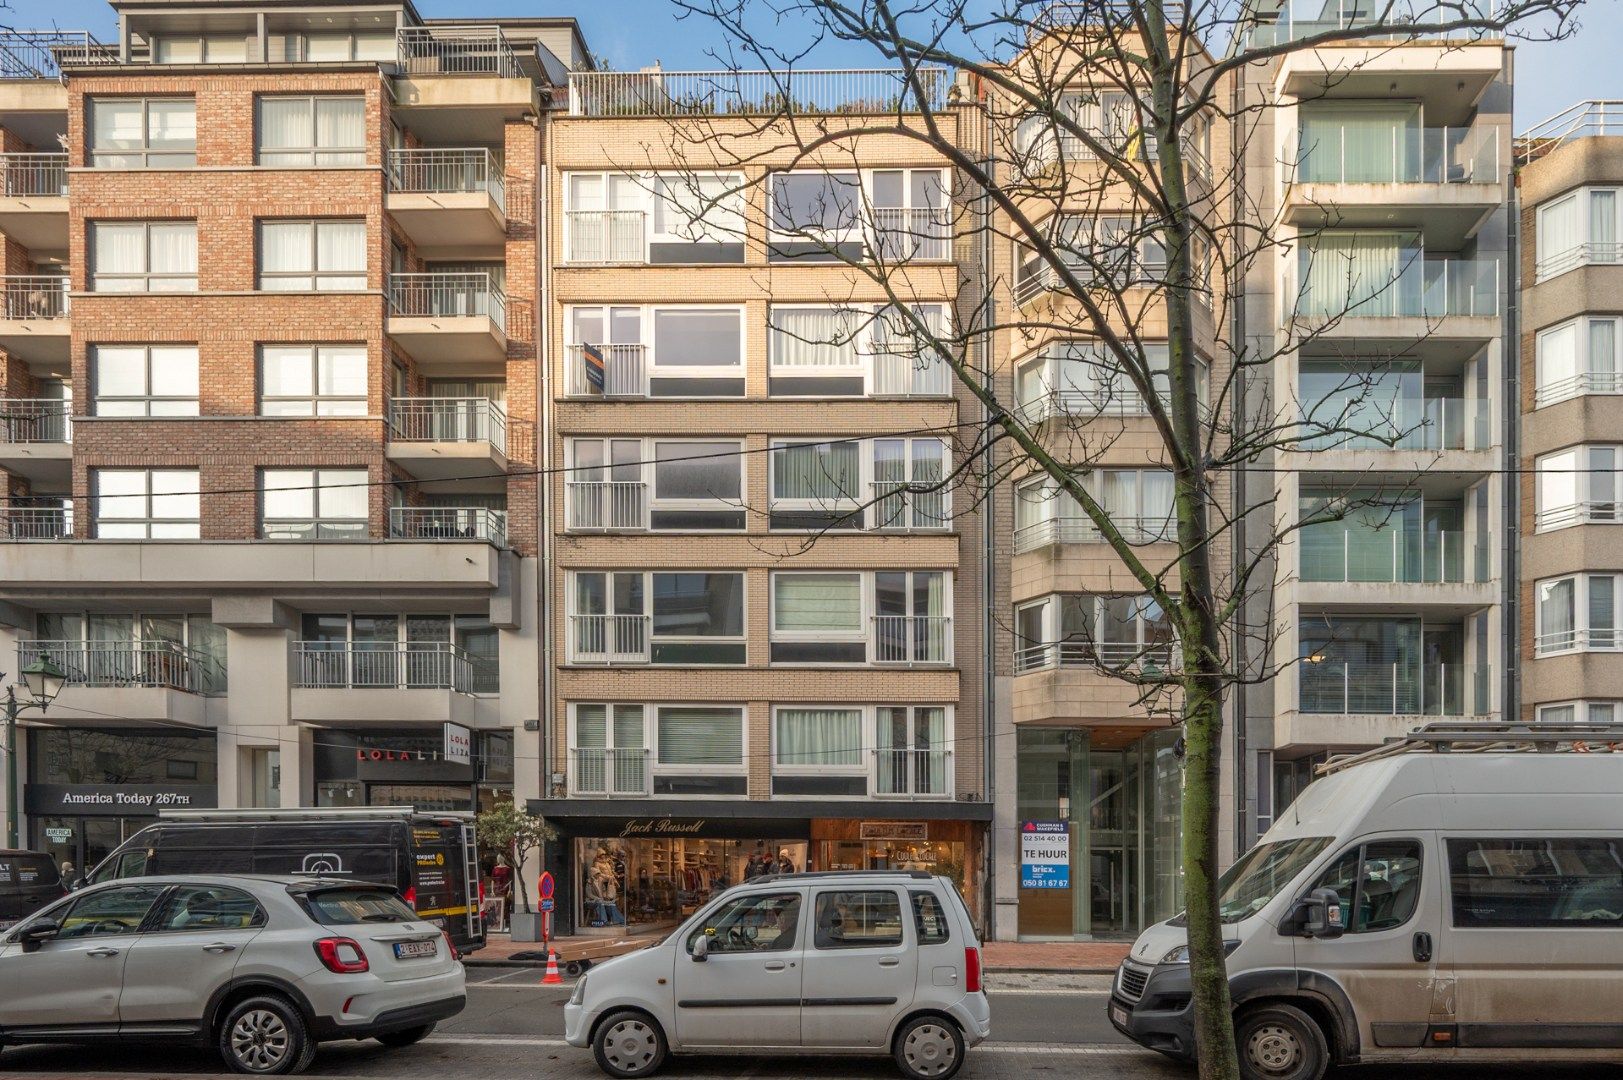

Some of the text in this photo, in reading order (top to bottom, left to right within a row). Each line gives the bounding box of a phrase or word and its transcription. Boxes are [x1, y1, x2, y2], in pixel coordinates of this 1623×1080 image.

[451, 734, 469, 746] LOLA
[357, 749, 410, 761] LOLA
[451, 747, 469, 757] LIZA
[62, 792, 190, 806] America Today 267TH
[46, 828, 71, 836] AMERICA
[619, 819, 705, 837] Jack Russell
[1024, 849, 1067, 859] TE HUUR
